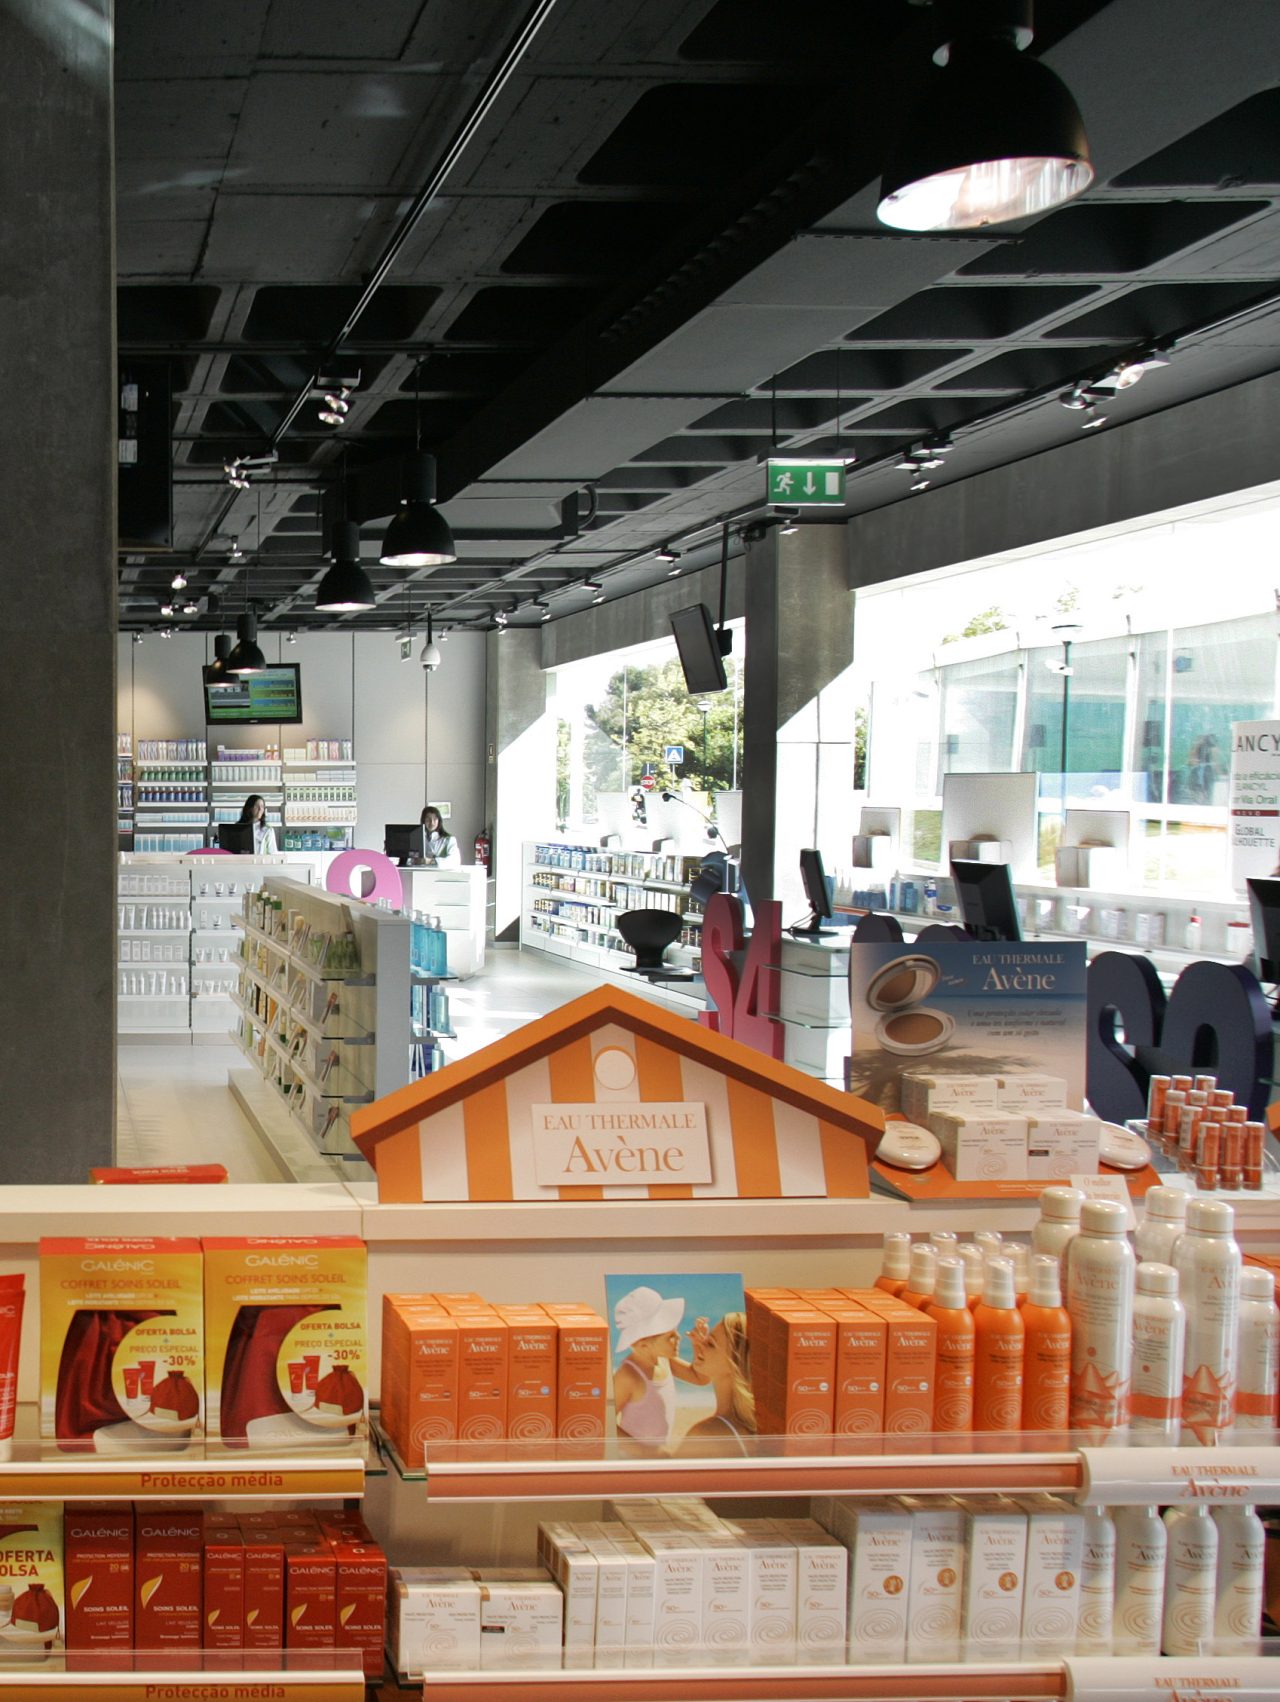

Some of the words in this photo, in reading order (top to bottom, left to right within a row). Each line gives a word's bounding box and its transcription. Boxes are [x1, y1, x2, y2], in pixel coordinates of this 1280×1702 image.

[972, 954, 992, 965] EAU
[1000, 953, 1065, 964] THERMALE
[982, 967, 1056, 990] Avène
[543, 1114, 582, 1130] EAU
[585, 1113, 697, 1130] THERMALE
[563, 1135, 684, 1173] Avène
[60, 1279, 107, 1289] COFFRET
[111, 1279, 143, 1289] SOINS
[147, 1279, 181, 1289] SOLEIL
[225, 1274, 271, 1284] COFFRET
[276, 1274, 309, 1284] SOINS
[312, 1274, 346, 1283] SOLEIL
[135, 1328, 167, 1336] OFERTA
[159, 1345, 198, 1353] ESPECIAL
[419, 1344, 449, 1355] Avène
[469, 1342, 499, 1353] Avène
[518, 1340, 548, 1350] Avène
[568, 1342, 599, 1352] Avène
[163, 1355, 196, 1366] -30%
[327, 1350, 360, 1360] -30%
[1172, 1466, 1196, 1476] EAU
[1198, 1466, 1258, 1476] THERMALE
[140, 1472, 225, 1490] Protecção
[231, 1471, 283, 1487] média
[1180, 1477, 1251, 1497] Avène
[1154, 1678, 1179, 1688] EAU
[1180, 1677, 1241, 1688] THERMALE
[146, 1685, 229, 1702] Protecção
[234, 1685, 285, 1698] média
